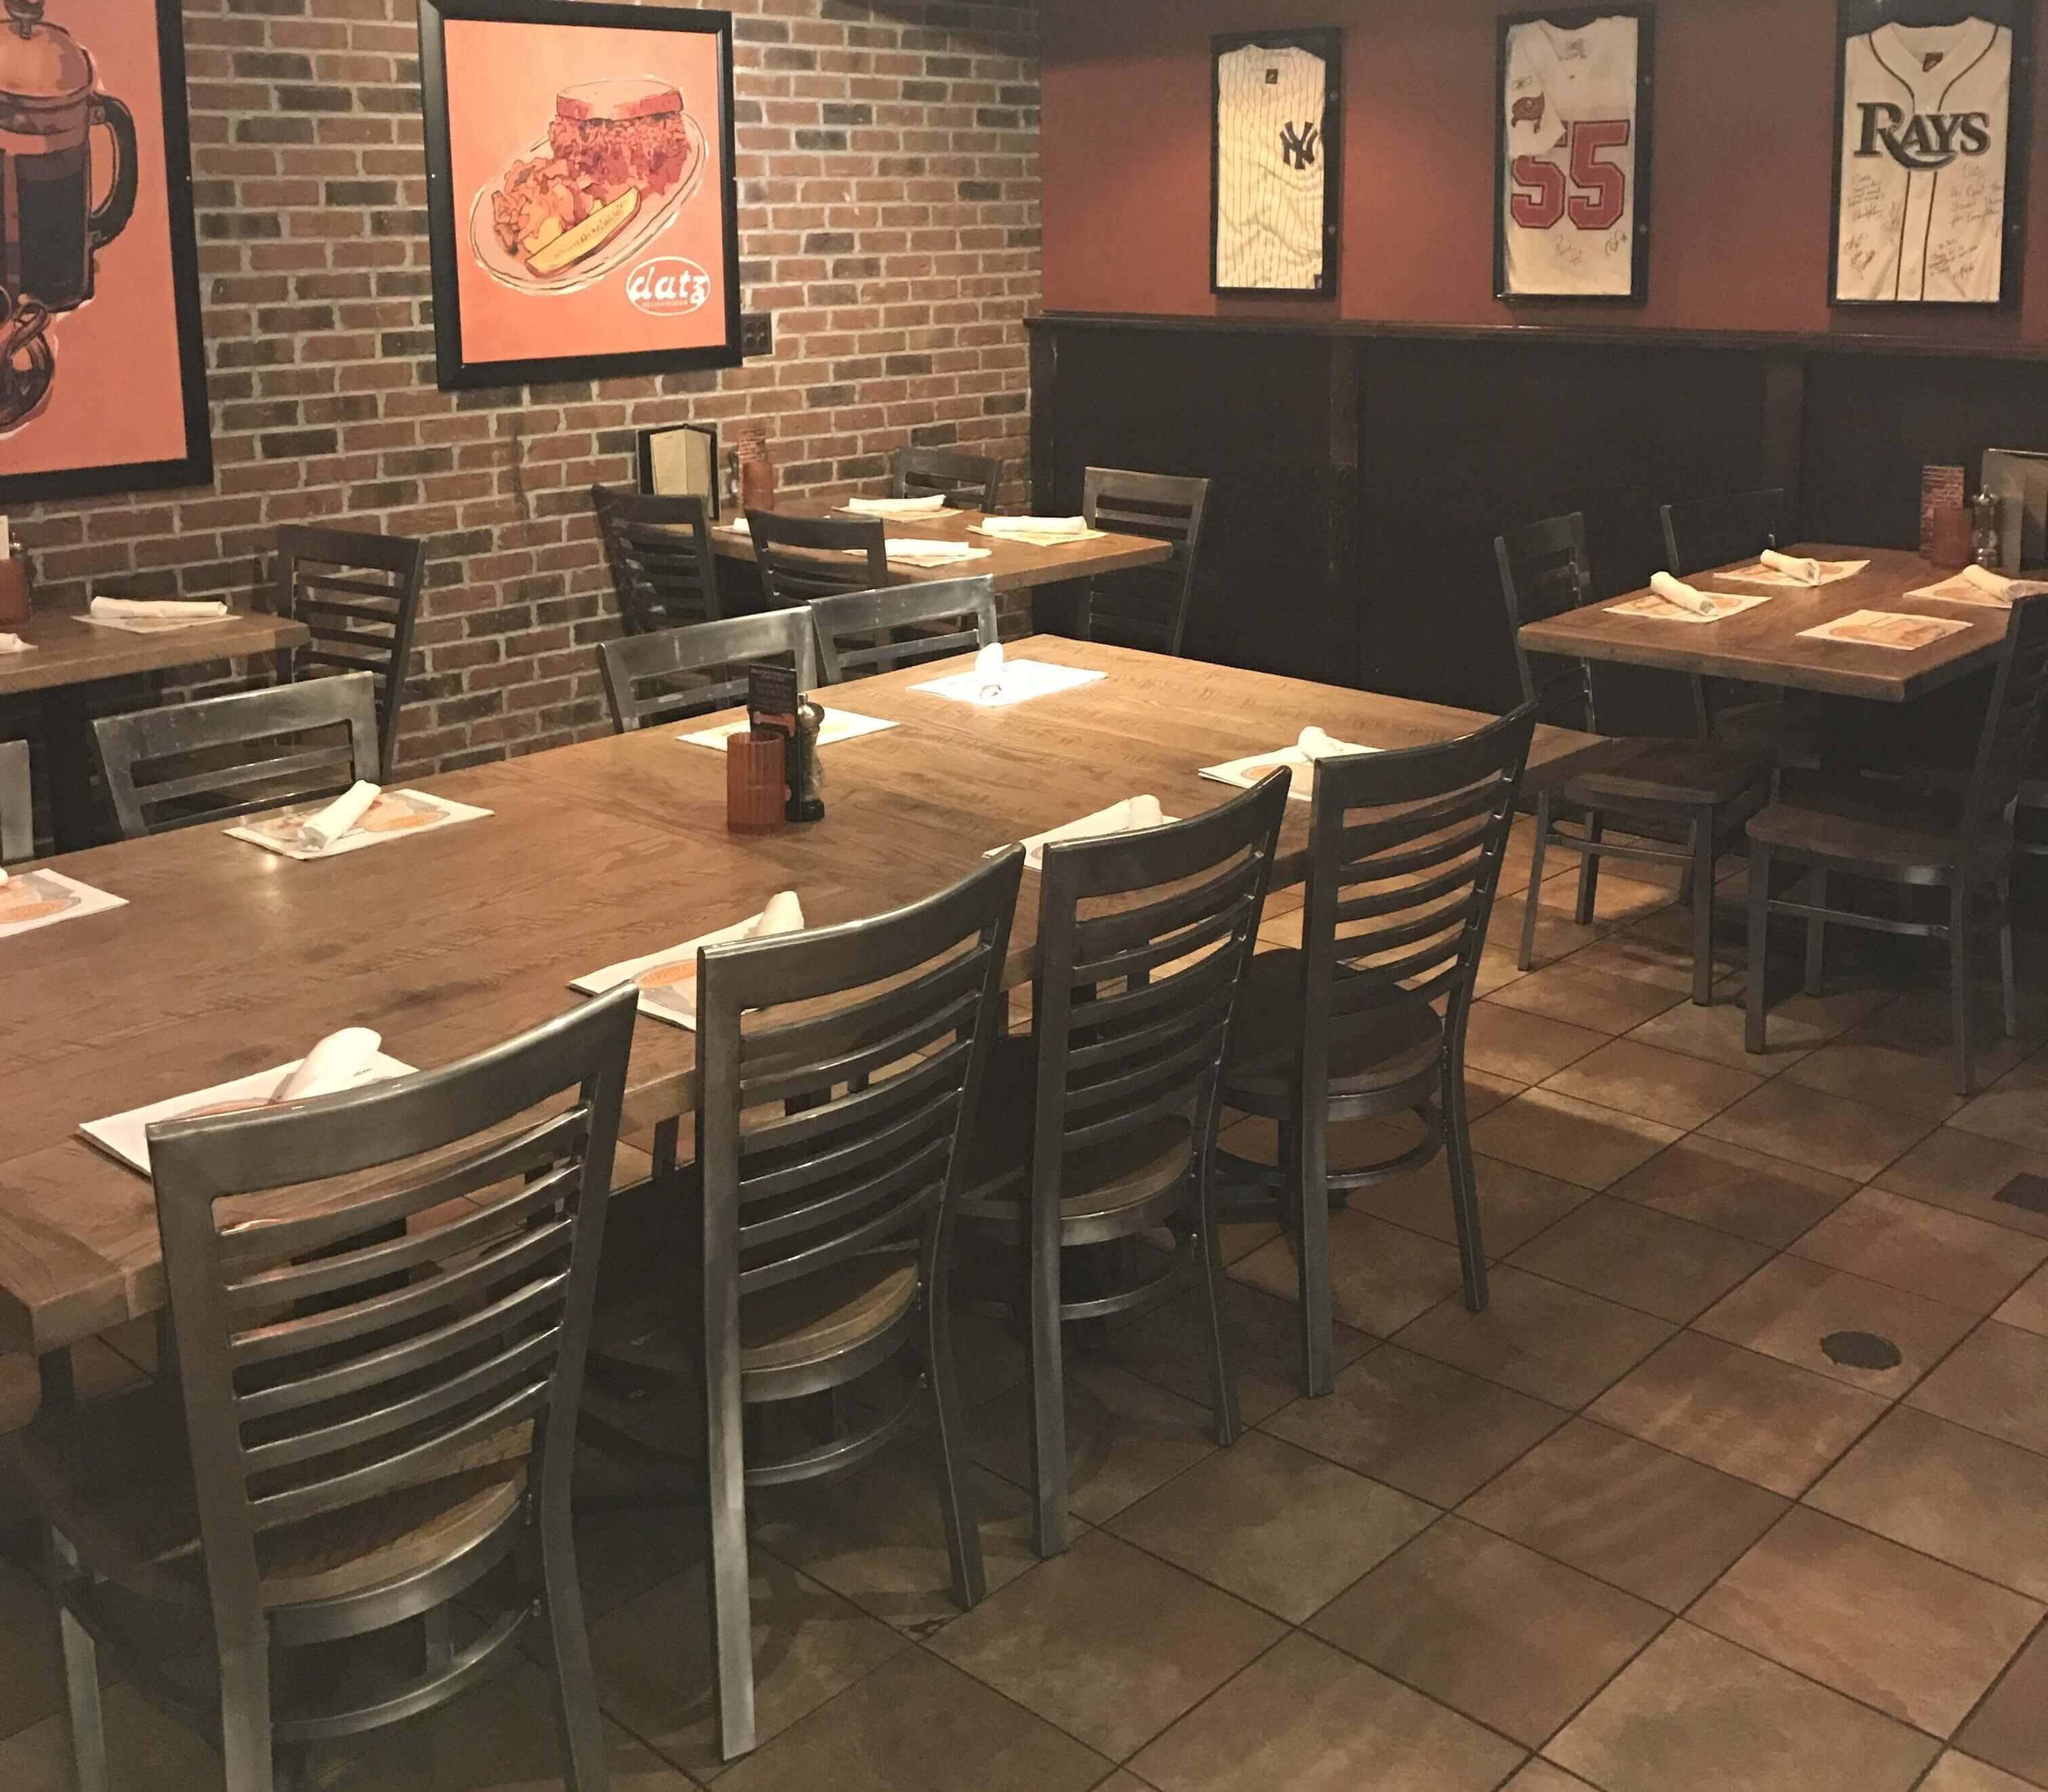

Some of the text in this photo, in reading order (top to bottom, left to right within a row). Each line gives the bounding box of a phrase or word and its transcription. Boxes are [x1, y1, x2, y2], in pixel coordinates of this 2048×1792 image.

[1279, 121, 1318, 169] NY
[1854, 102, 1991, 171] RAYS
[628, 266, 708, 305] datz
